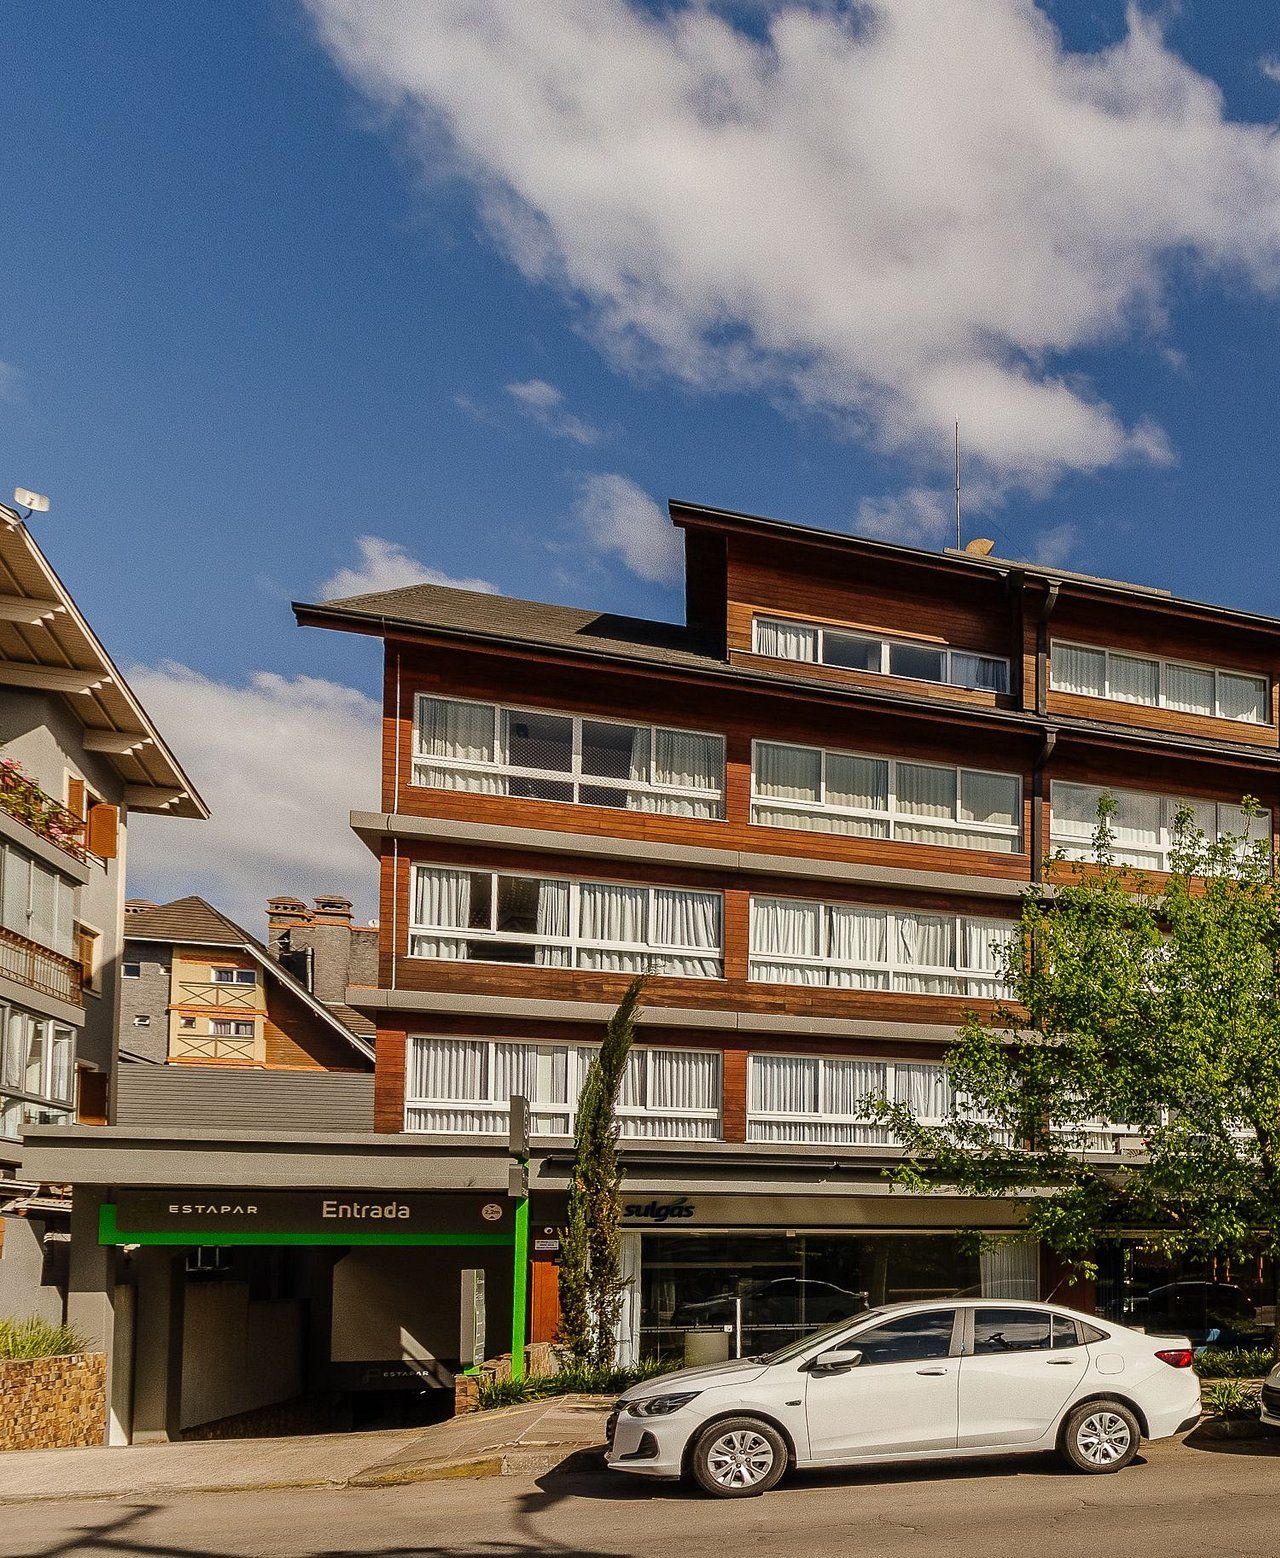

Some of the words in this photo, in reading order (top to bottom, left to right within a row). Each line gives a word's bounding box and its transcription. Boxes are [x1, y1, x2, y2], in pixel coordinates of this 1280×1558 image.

[169, 1205, 258, 1214] ESTAPAR
[322, 1201, 410, 1218] Entrada
[623, 1197, 696, 1222] sulgás
